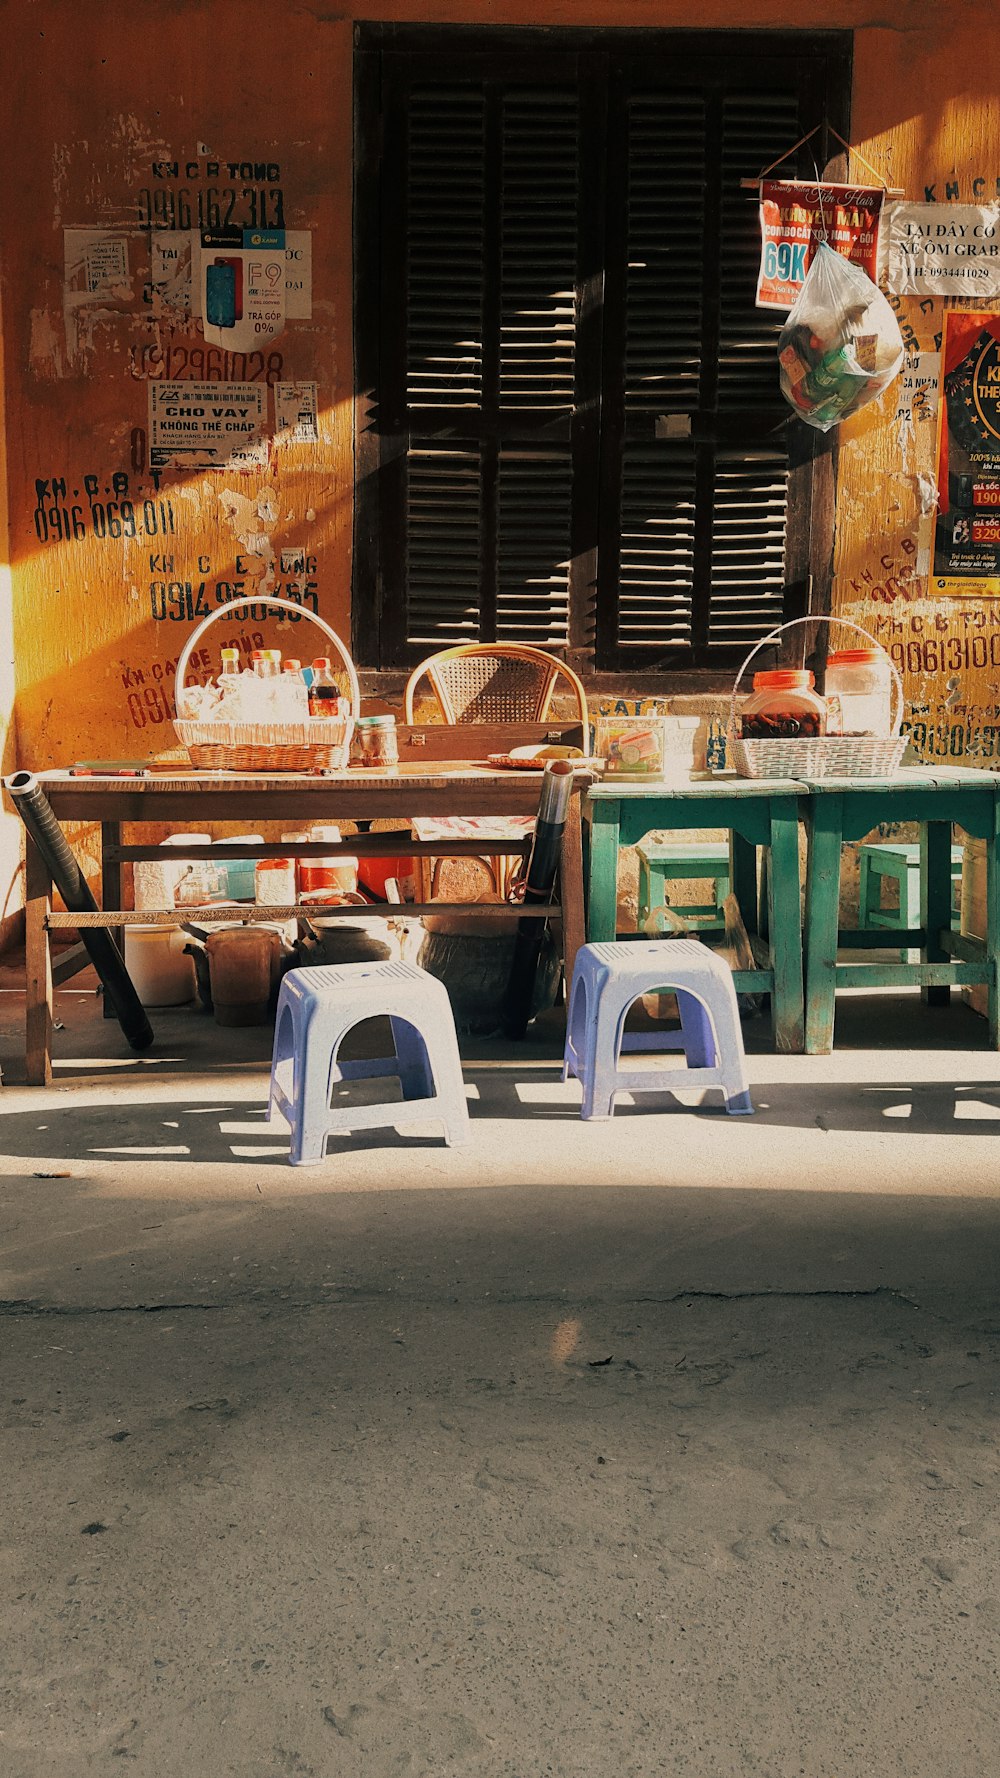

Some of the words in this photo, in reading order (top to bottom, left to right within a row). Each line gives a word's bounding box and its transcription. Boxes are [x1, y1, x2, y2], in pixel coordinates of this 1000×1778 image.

[936, 220, 969, 238] ĐÂY
[924, 240, 950, 256] ÔM
[955, 244, 999, 256] GRAB
[764, 241, 810, 283] 69K
[248, 262, 282, 288] F9
[930, 267, 989, 278] 0934441029
[265, 310, 281, 321] GÓP
[254, 322, 274, 334] 0%
[165, 407, 205, 417] CHO
[212, 408, 249, 418] VAY
[160, 419, 199, 431] KHÔNG
